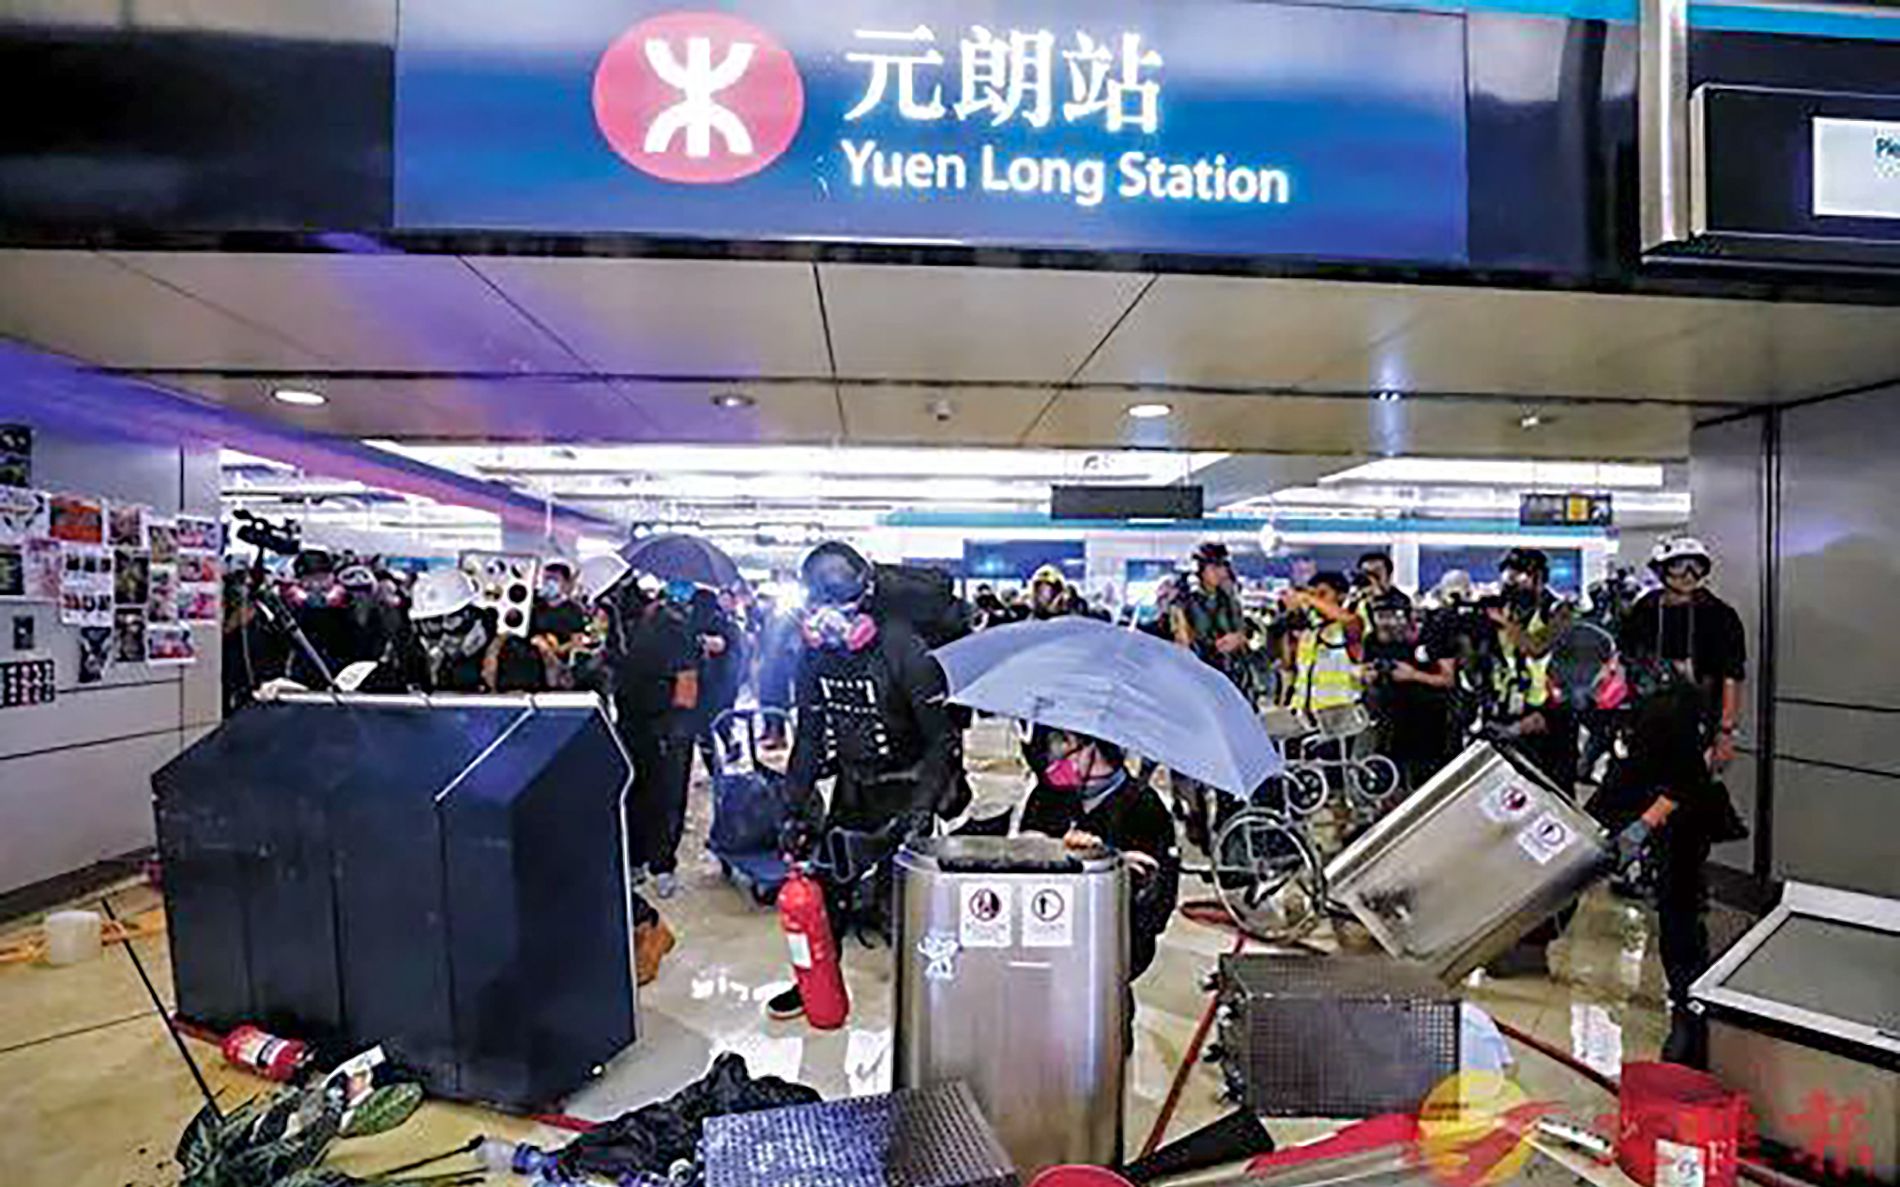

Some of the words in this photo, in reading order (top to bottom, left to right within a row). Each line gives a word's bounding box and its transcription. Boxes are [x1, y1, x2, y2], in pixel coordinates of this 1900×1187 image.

[843, 24, 1164, 133] 元朗站
[841, 139, 966, 188] Yuen
[981, 144, 1105, 205] Long
[1117, 151, 1289, 203] Station
